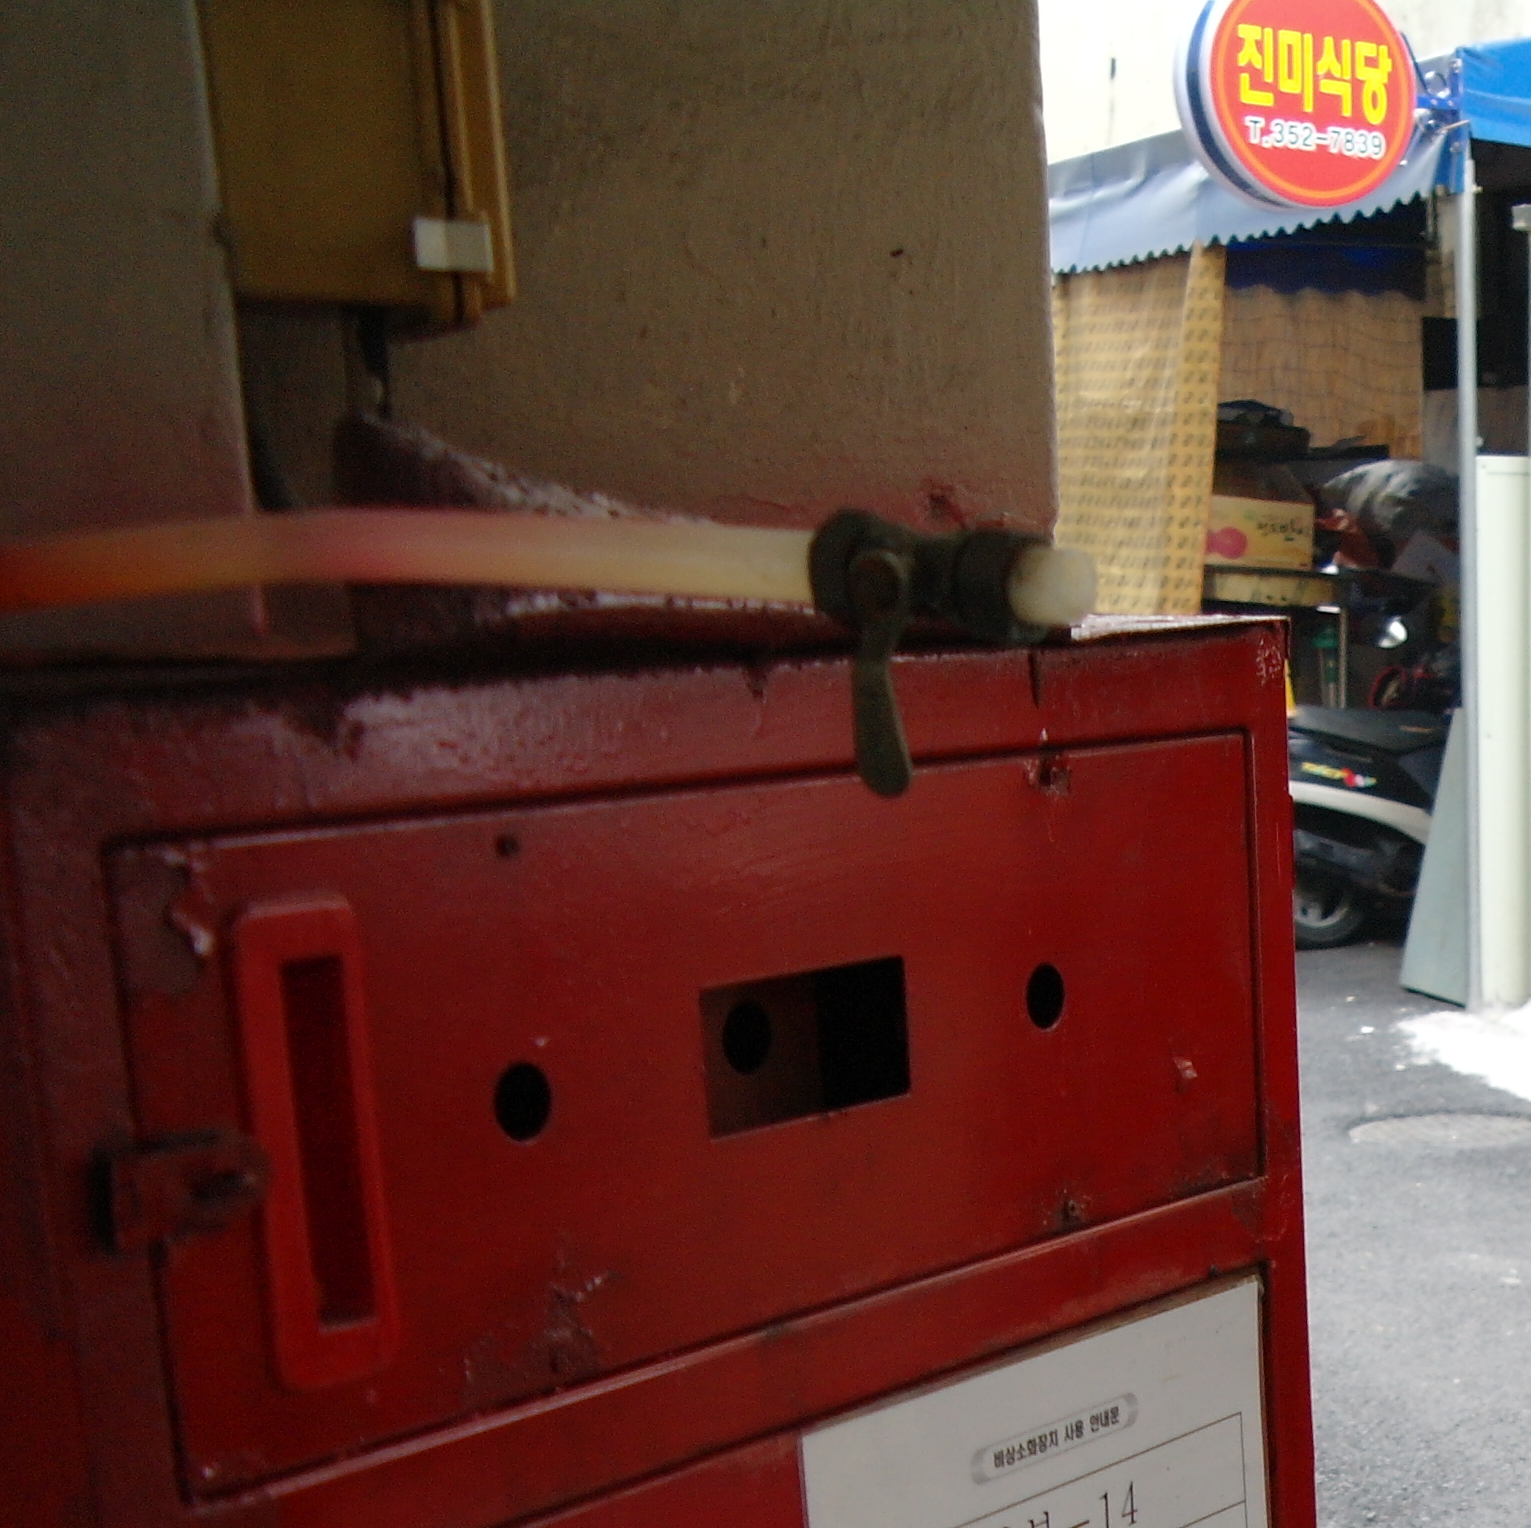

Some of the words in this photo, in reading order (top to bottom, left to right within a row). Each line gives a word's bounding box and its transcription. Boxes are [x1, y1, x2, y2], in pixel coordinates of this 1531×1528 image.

[1237, 23, 1392, 125] 진미식당
[1244, 116, 1387, 159] T.352-7839
[1064, 1419, 1084, 1442] 사용
[1089, 1405, 1120, 1434] 안내문
